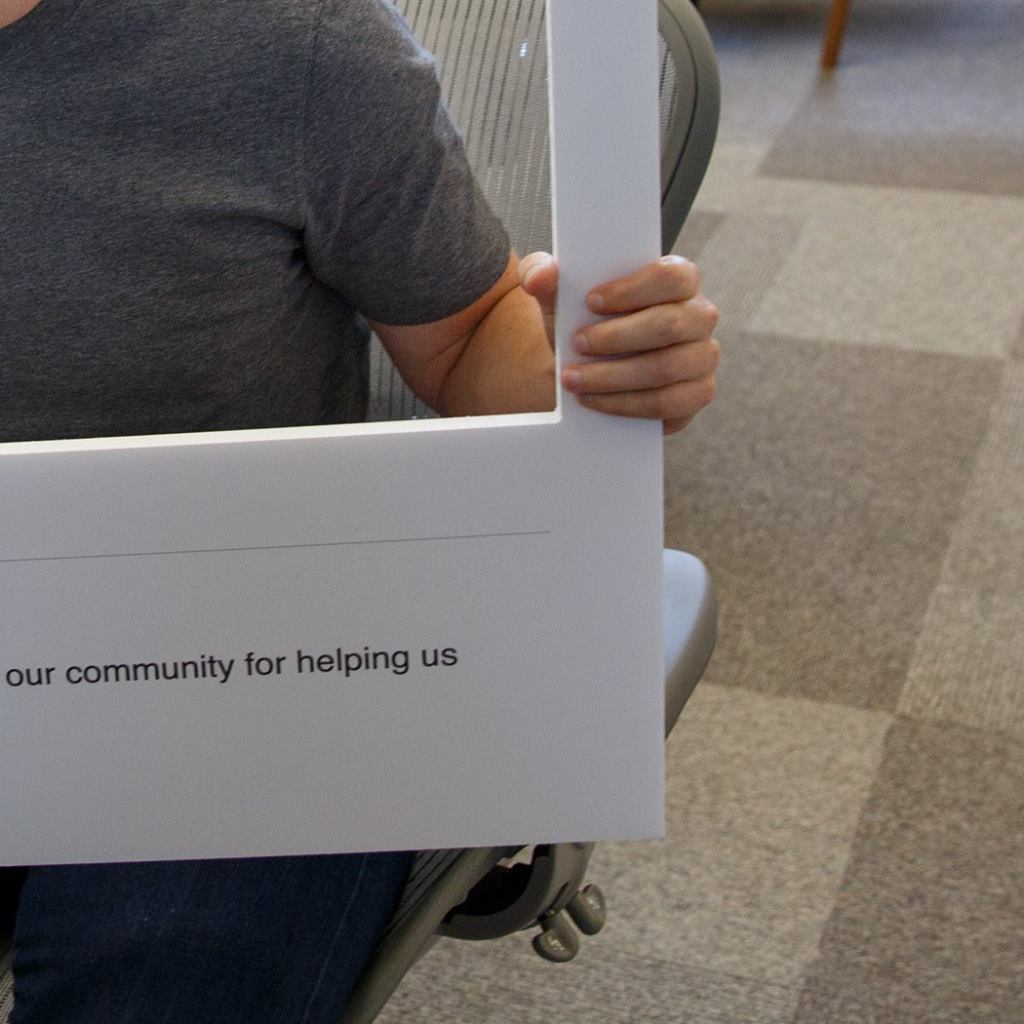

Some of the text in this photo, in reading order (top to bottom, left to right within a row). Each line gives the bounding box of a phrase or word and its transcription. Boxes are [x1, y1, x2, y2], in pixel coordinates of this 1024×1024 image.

[5, 666, 56, 688] our
[65, 654, 236, 685] community
[243, 651, 287, 677] for
[296, 646, 410, 678] helping
[421, 647, 459, 668] us
